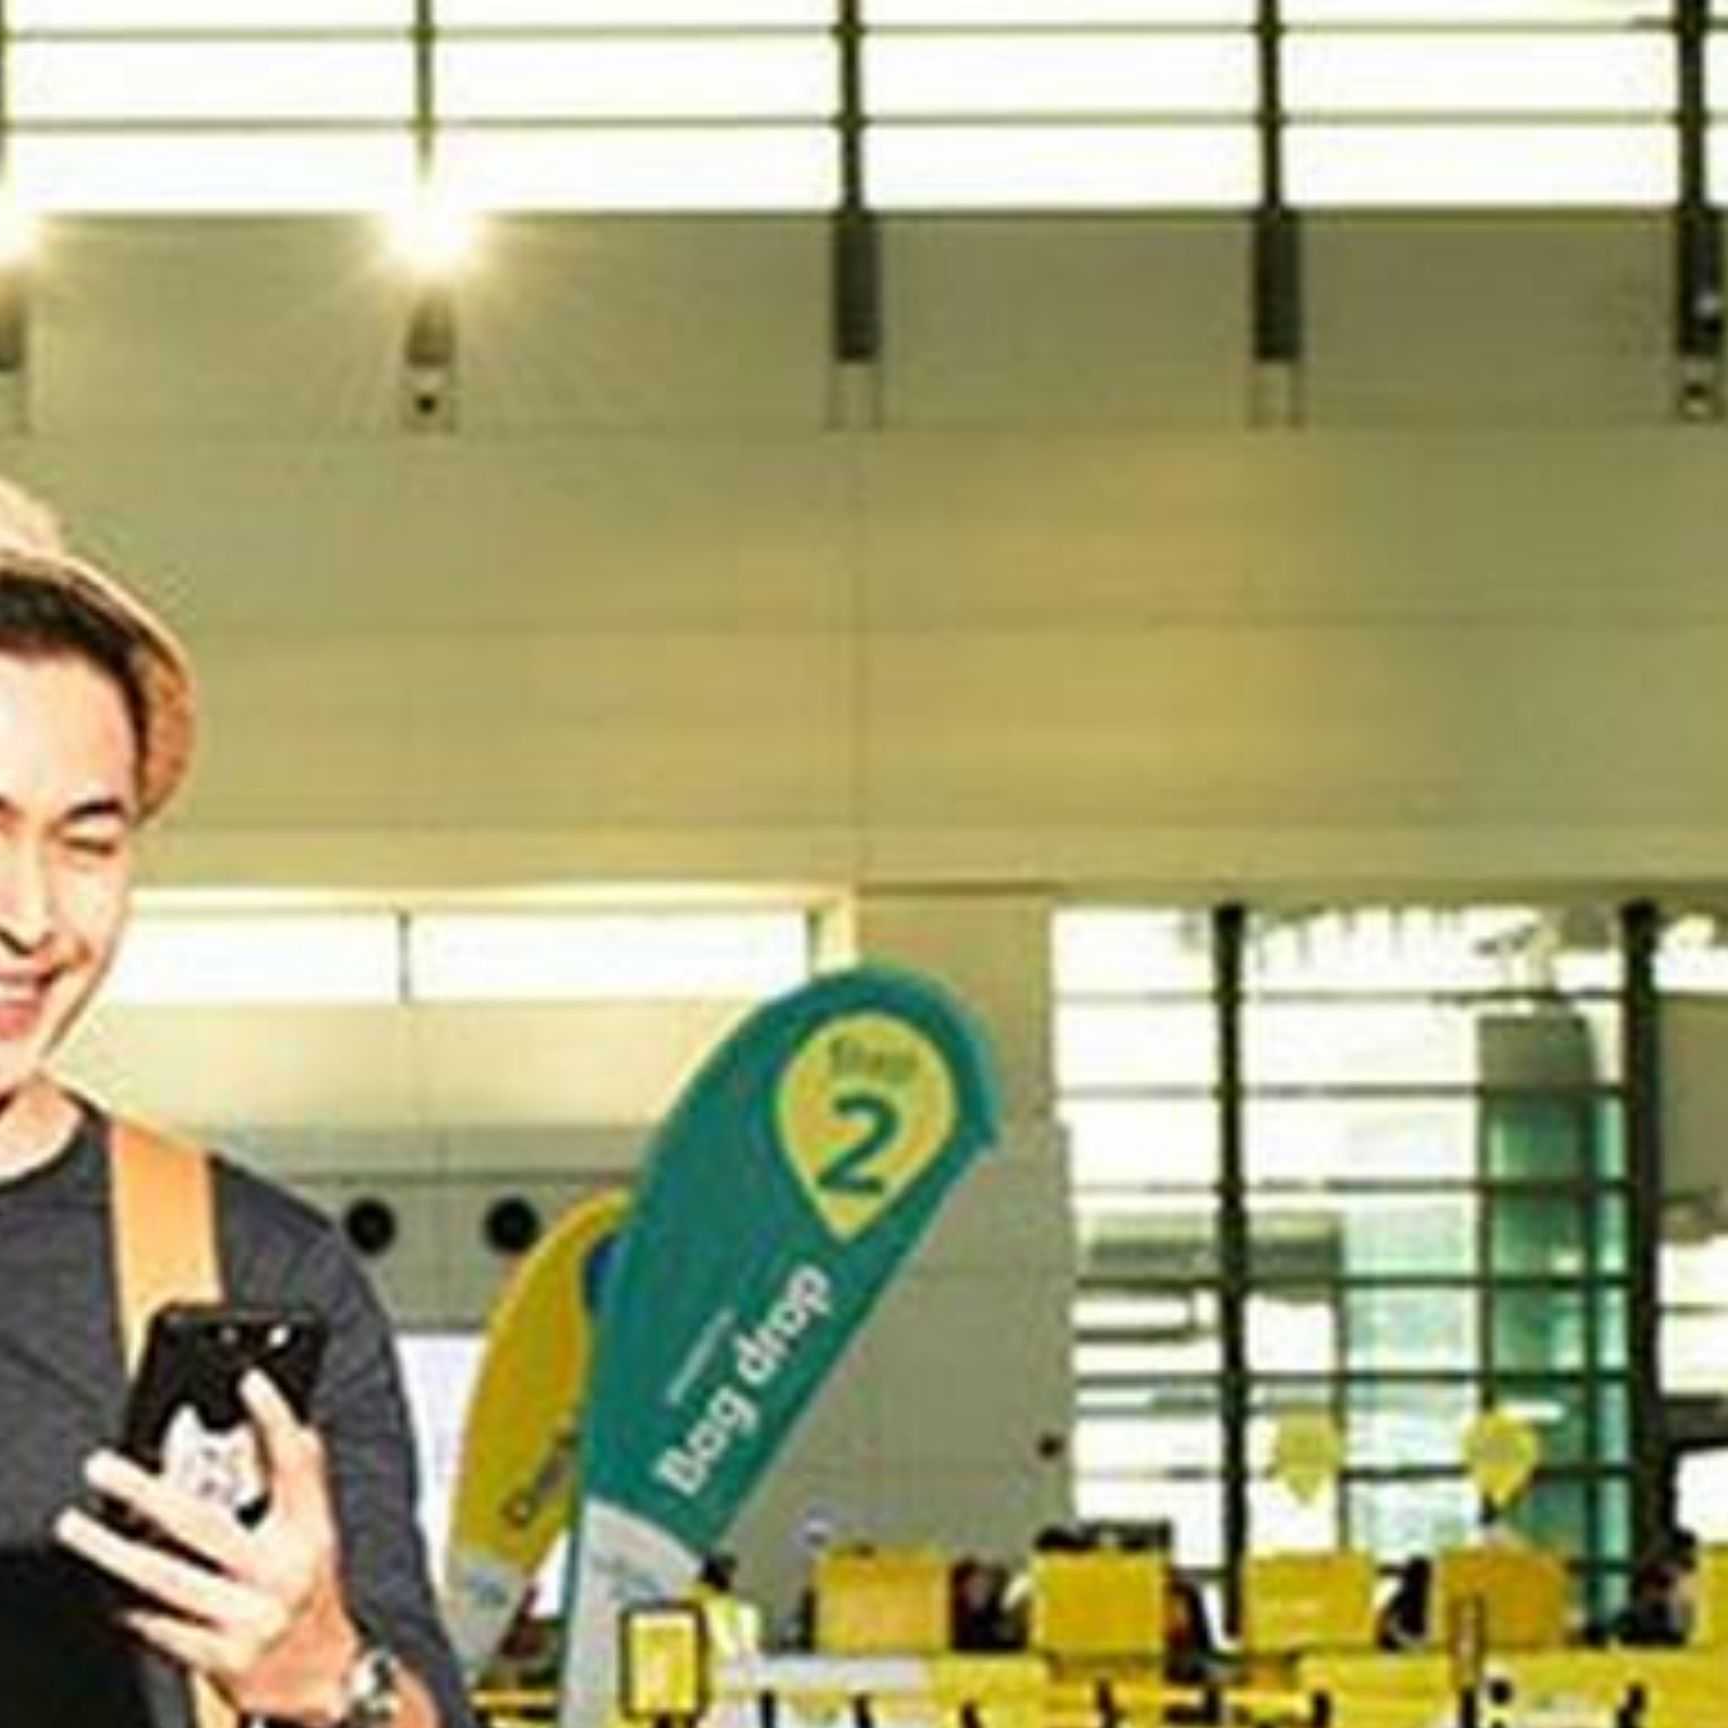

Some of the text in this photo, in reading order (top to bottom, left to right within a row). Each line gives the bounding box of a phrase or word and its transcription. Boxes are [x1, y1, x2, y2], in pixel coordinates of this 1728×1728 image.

[816, 1092, 900, 1193] 2
[652, 1384, 759, 1496] Bag
[734, 1264, 832, 1386] drop
